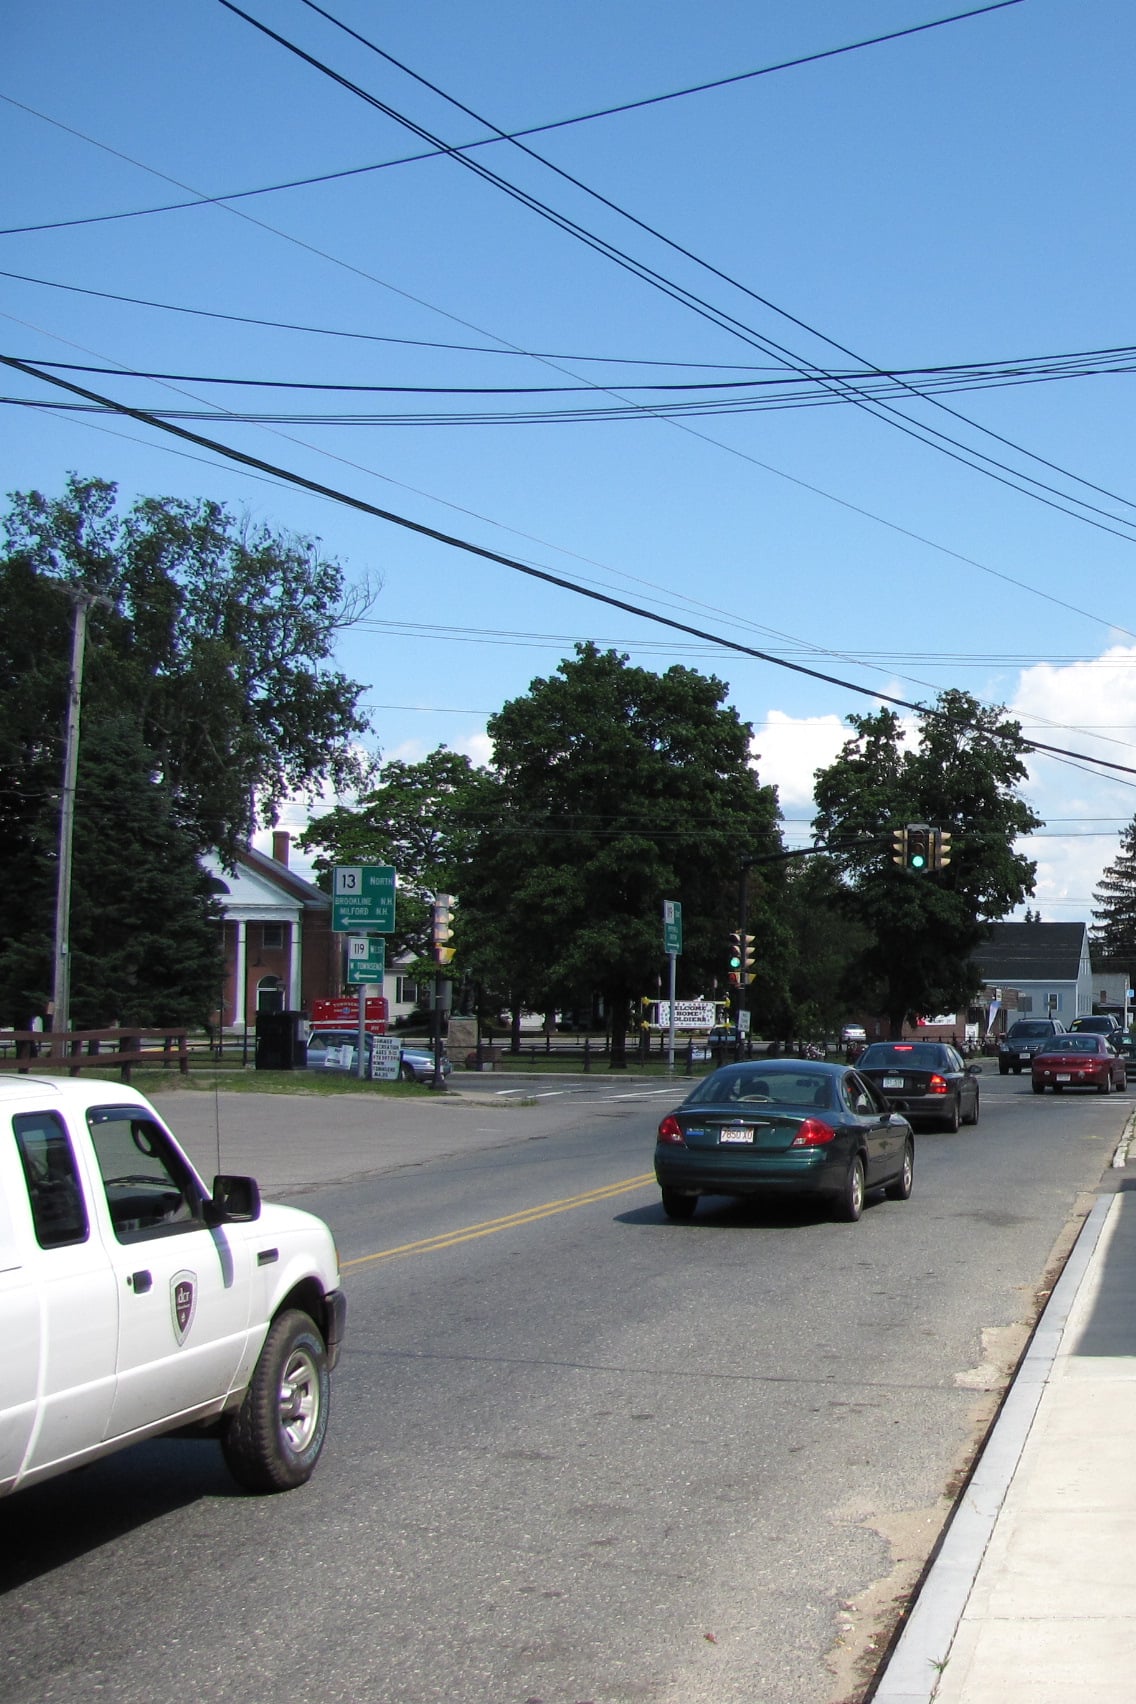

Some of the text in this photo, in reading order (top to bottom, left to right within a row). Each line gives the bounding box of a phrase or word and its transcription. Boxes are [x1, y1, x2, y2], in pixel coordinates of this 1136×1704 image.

[342, 874, 356, 889] 13
[370, 876, 393, 886] NORTH
[335, 897, 372, 906] BROOKLINE
[340, 907, 369, 916] MILFORD
[354, 943, 365, 955] 119
